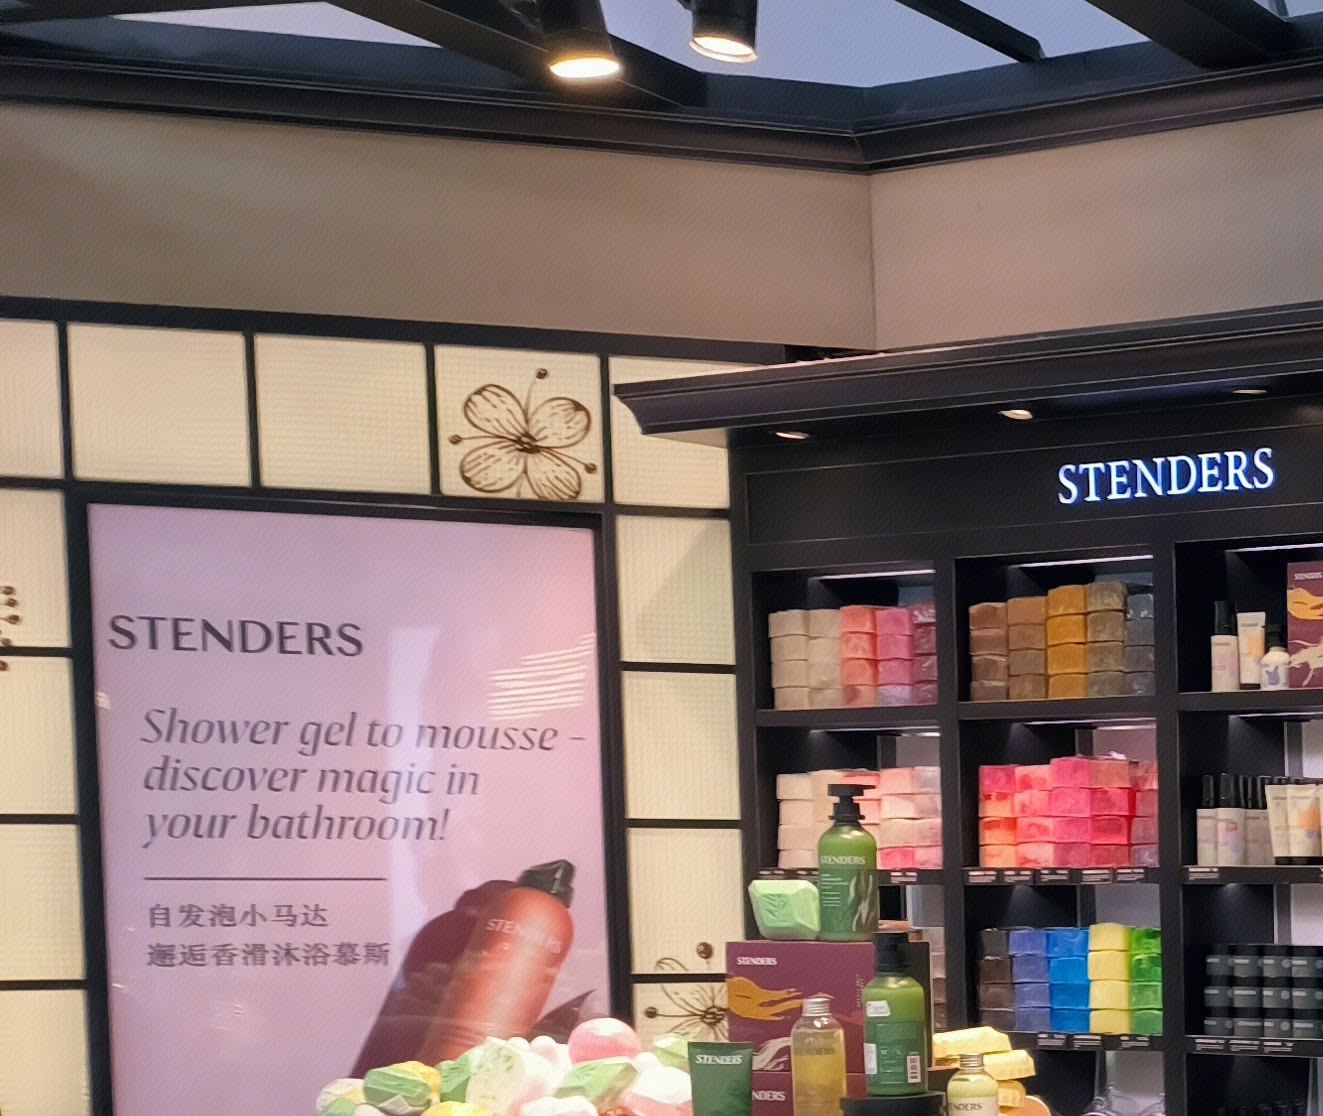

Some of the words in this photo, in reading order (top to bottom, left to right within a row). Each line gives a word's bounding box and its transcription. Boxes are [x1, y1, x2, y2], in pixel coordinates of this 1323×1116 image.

[1057, 447, 1275, 504] STENDERS
[108, 614, 363, 657] STENDERS
[140, 707, 290, 745] Shower
[299, 711, 357, 756] gel
[367, 719, 403, 747] to
[414, 724, 559, 751] mousse
[143, 755, 307, 793] discover
[317, 763, 435, 804] magic
[446, 764, 479, 795] in
[142, 812, 237, 848] your
[246, 804, 450, 841] bathroom!
[820, 856, 866, 866] STENDERS
[148, 904, 328, 928] 自发泡小马达
[146, 942, 389, 967] 邂逅香滑沐浴慕斯
[736, 956, 777, 966] STENDERS
[695, 1054, 743, 1065] STENDERS
[751, 1091, 786, 1101] NDERS
[949, 1102, 982, 1112] ENDERS
